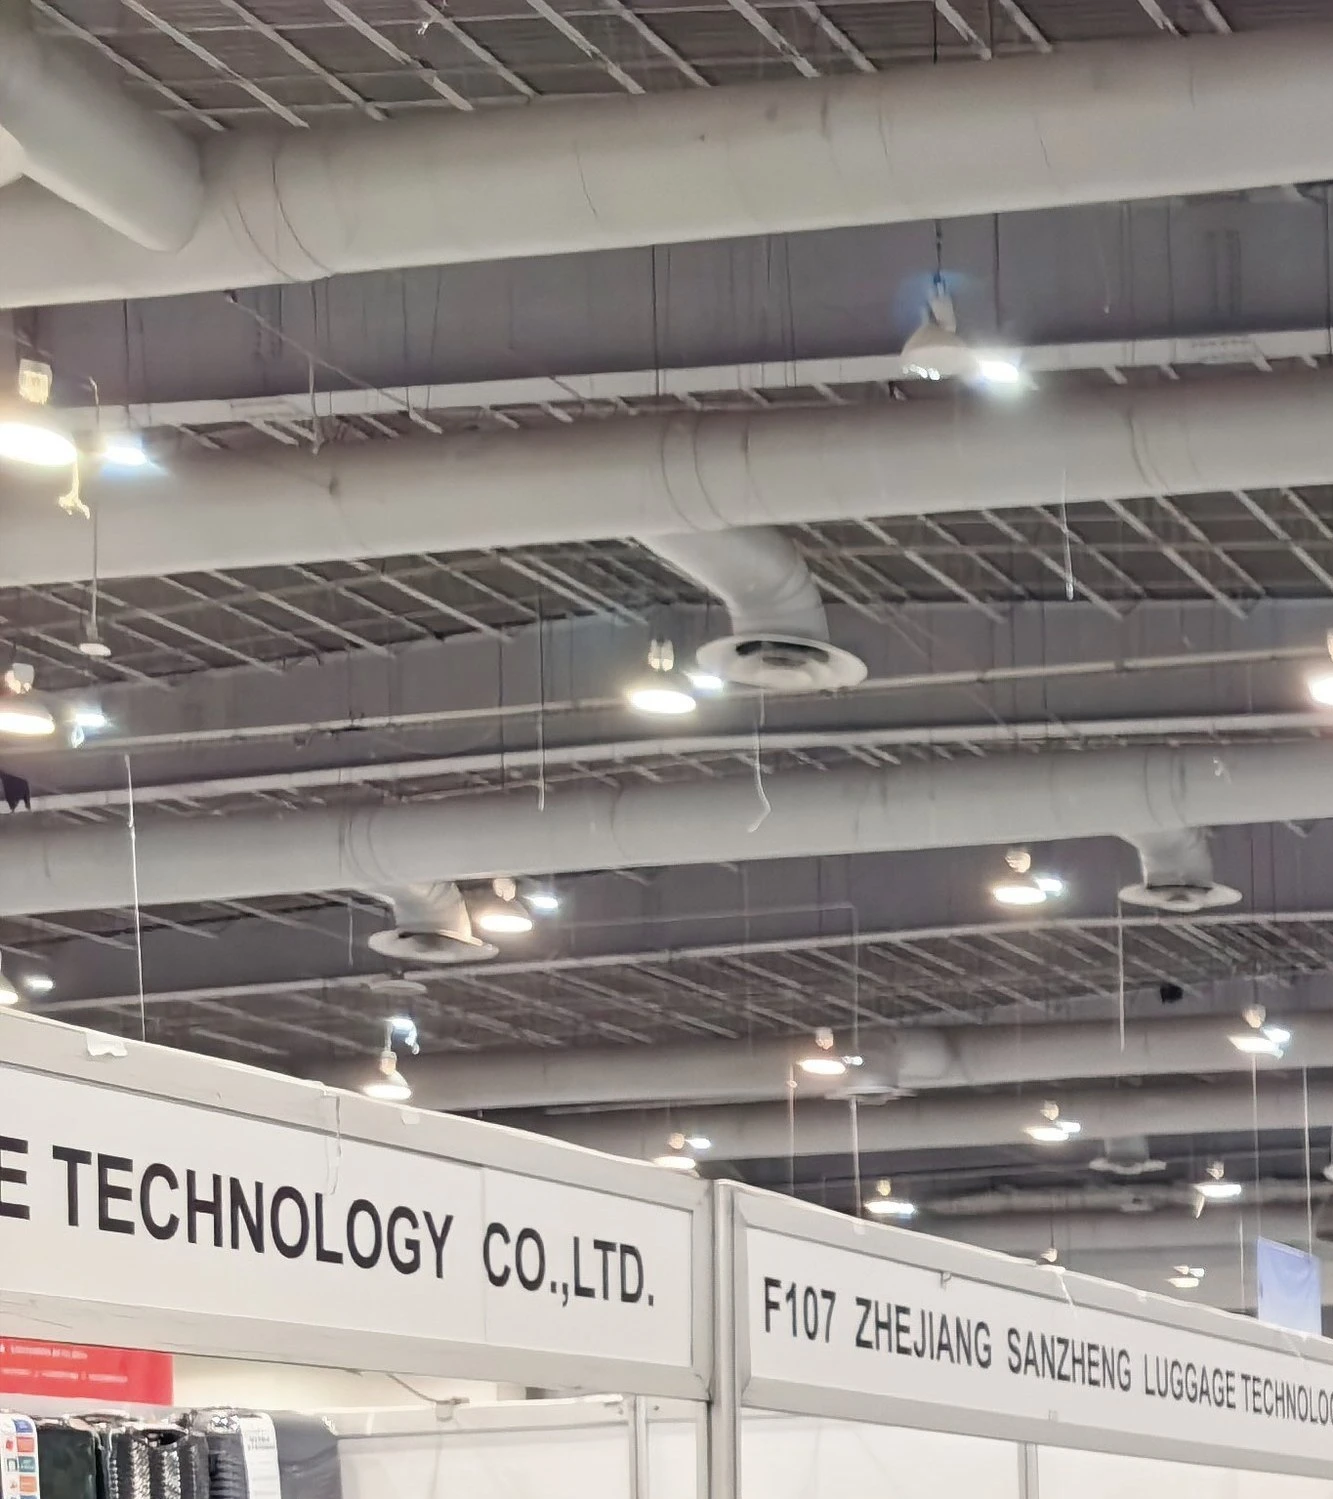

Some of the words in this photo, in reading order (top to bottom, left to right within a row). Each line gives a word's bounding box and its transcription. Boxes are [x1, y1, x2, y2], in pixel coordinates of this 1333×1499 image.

[52, 1144, 454, 1279] TECHNOLOGY
[483, 1222, 654, 1307] CO.,LTD.
[764, 1277, 835, 1344] F107
[855, 1295, 993, 1370] ZHEJIANG
[1007, 1326, 1132, 1394] SANZHENG
[1144, 1357, 1236, 1412] LUGGAGE
